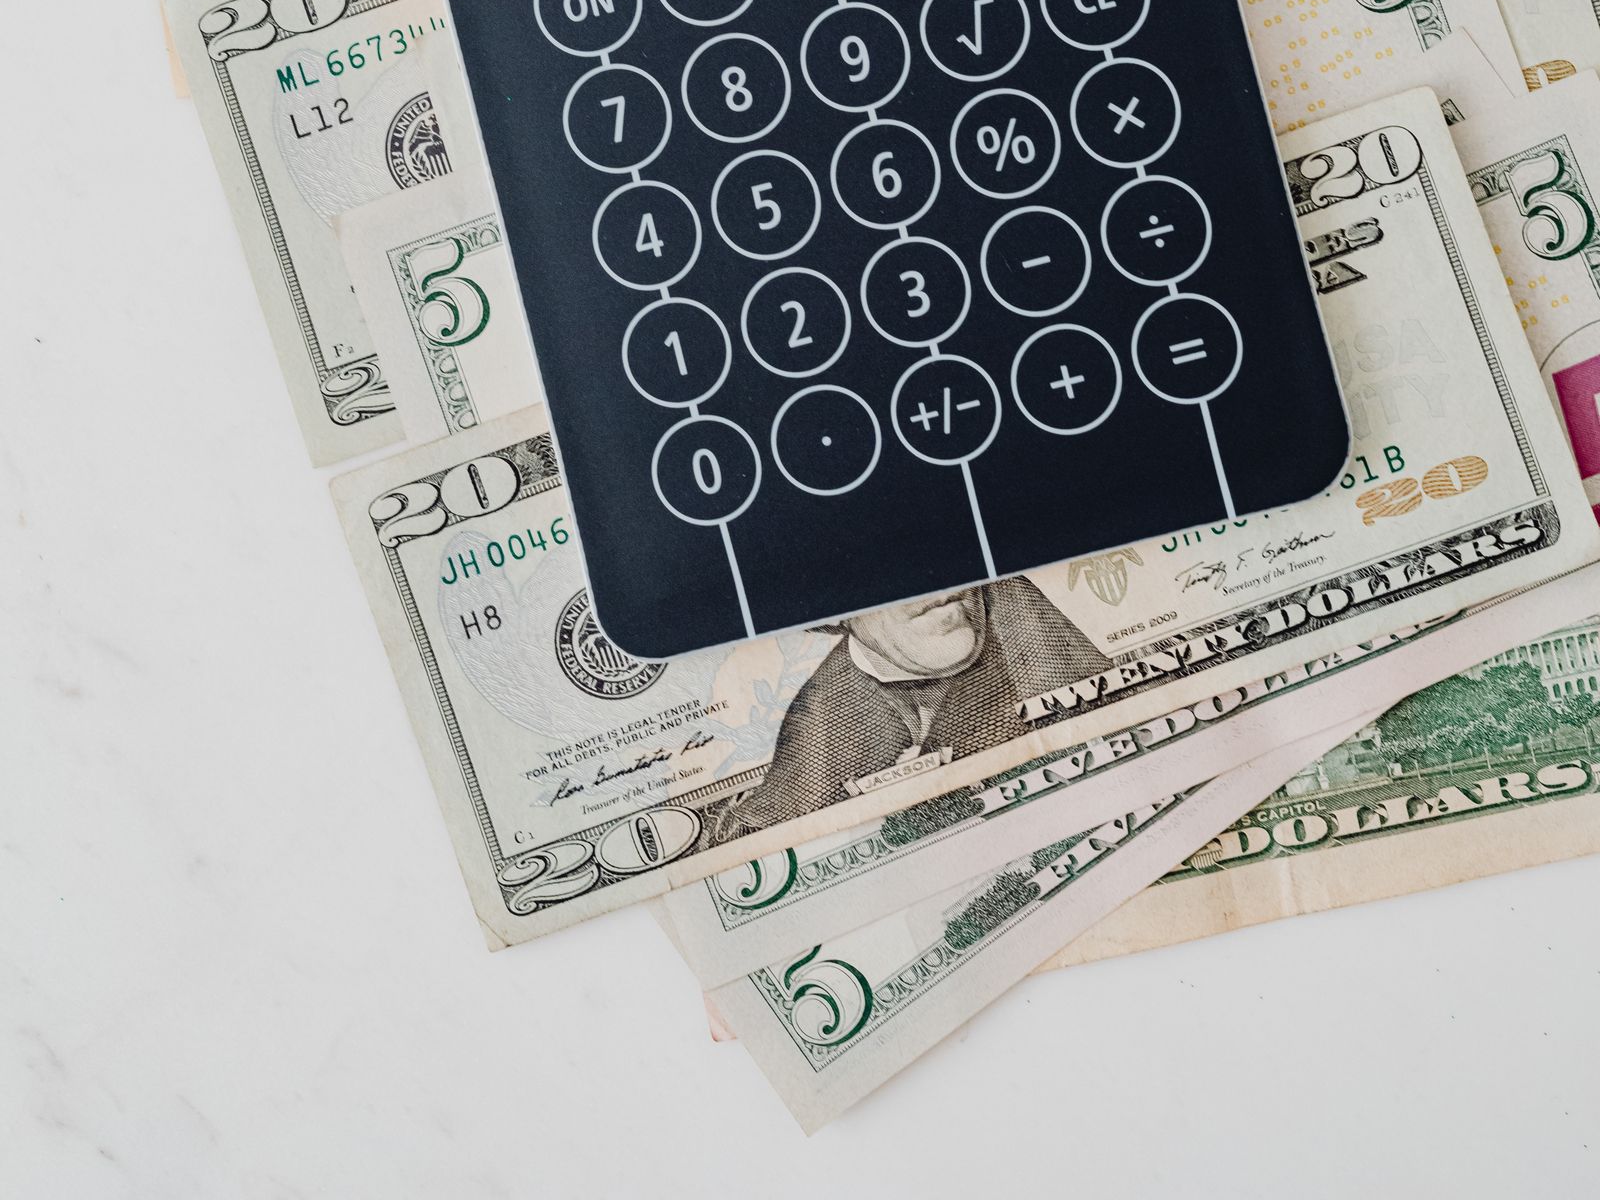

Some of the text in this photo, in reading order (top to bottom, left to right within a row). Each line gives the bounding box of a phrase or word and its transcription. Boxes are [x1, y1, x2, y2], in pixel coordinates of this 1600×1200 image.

[839, 35, 871, 83] 9
[720, 65, 754, 113] 8
[288, 97, 354, 140] L12
[393, 99, 431, 138] UNITED
[600, 95, 626, 144] 7
[976, 117, 1037, 172] %
[1300, 125, 1423, 209] 20
[871, 151, 903, 199] 6
[750, 181, 782, 231] 5
[1503, 148, 1597, 261] 5
[635, 212, 665, 258] 4
[403, 236, 491, 347] 5
[899, 270, 931, 318] 3
[780, 300, 814, 349] 2
[663, 330, 688, 376] 1
[692, 448, 722, 495] 0
[1354, 455, 1489, 527] 20
[368, 455, 522, 549] 20
[460, 604, 503, 640] H8
[562, 595, 590, 631] UNIT
[1013, 518, 1546, 724] TWENTY DOLLARS
[1106, 610, 1179, 644] SERIES 2009
[560, 643, 599, 691] FEDERAL
[525, 766, 549, 780] FOR
[551, 758, 574, 772] ALL
[616, 727, 657, 748] PUBLIC
[659, 717, 683, 733] AND
[685, 700, 730, 723] PRIVATE
[546, 699, 701, 762] THIS NOTE IS LEGAL TENDER
[864, 755, 937, 790] JACKSON
[978, 736, 1138, 815] FIVE
[1216, 758, 1590, 863] DOLLARS
[1256, 800, 1327, 823] CAPITOL
[497, 804, 706, 917] 20
[783, 942, 874, 1048] 5
